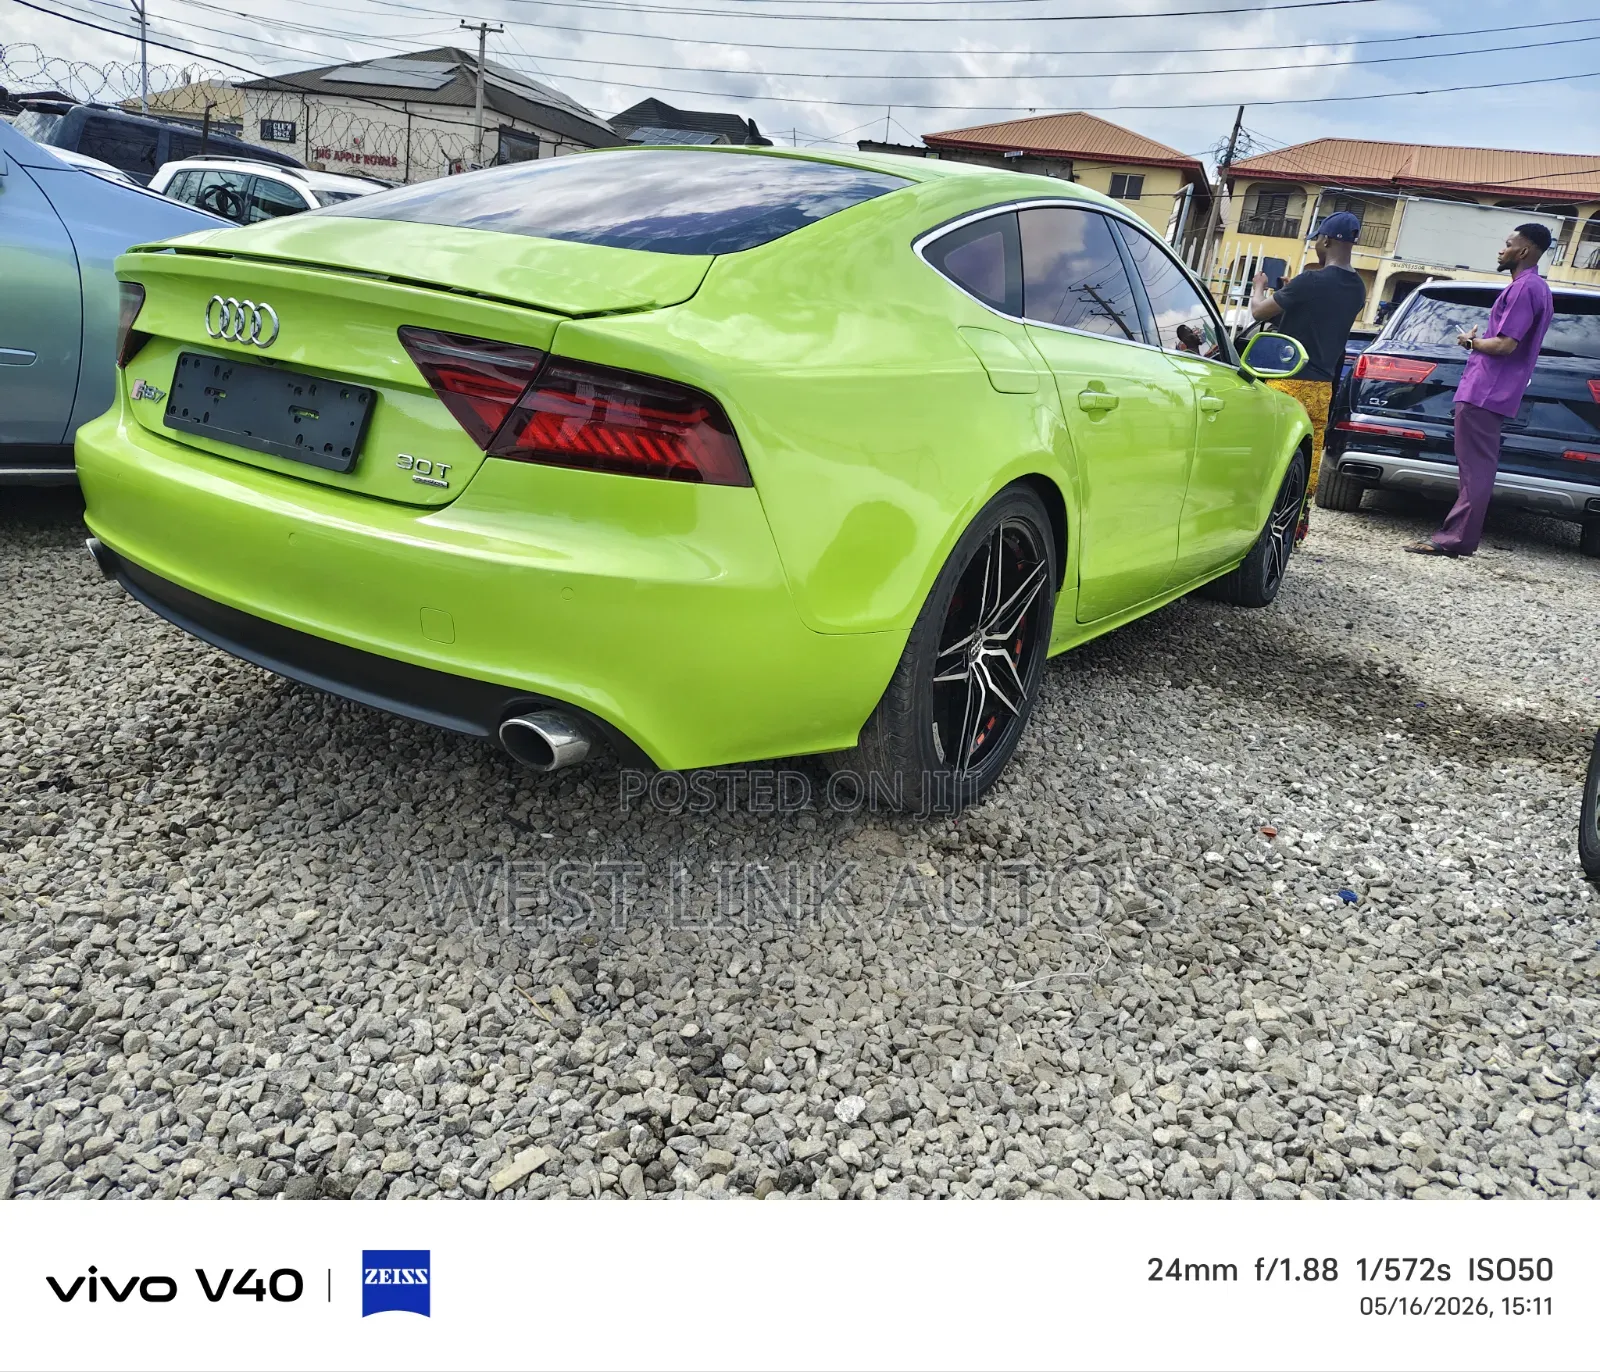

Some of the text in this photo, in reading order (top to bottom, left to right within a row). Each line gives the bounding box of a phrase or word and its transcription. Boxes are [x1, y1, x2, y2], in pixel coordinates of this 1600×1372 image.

[333, 150, 361, 164] APPLE
[131, 378, 167, 404] RS7
[1369, 397, 1389, 406] Q7
[396, 453, 453, 479] 30T
